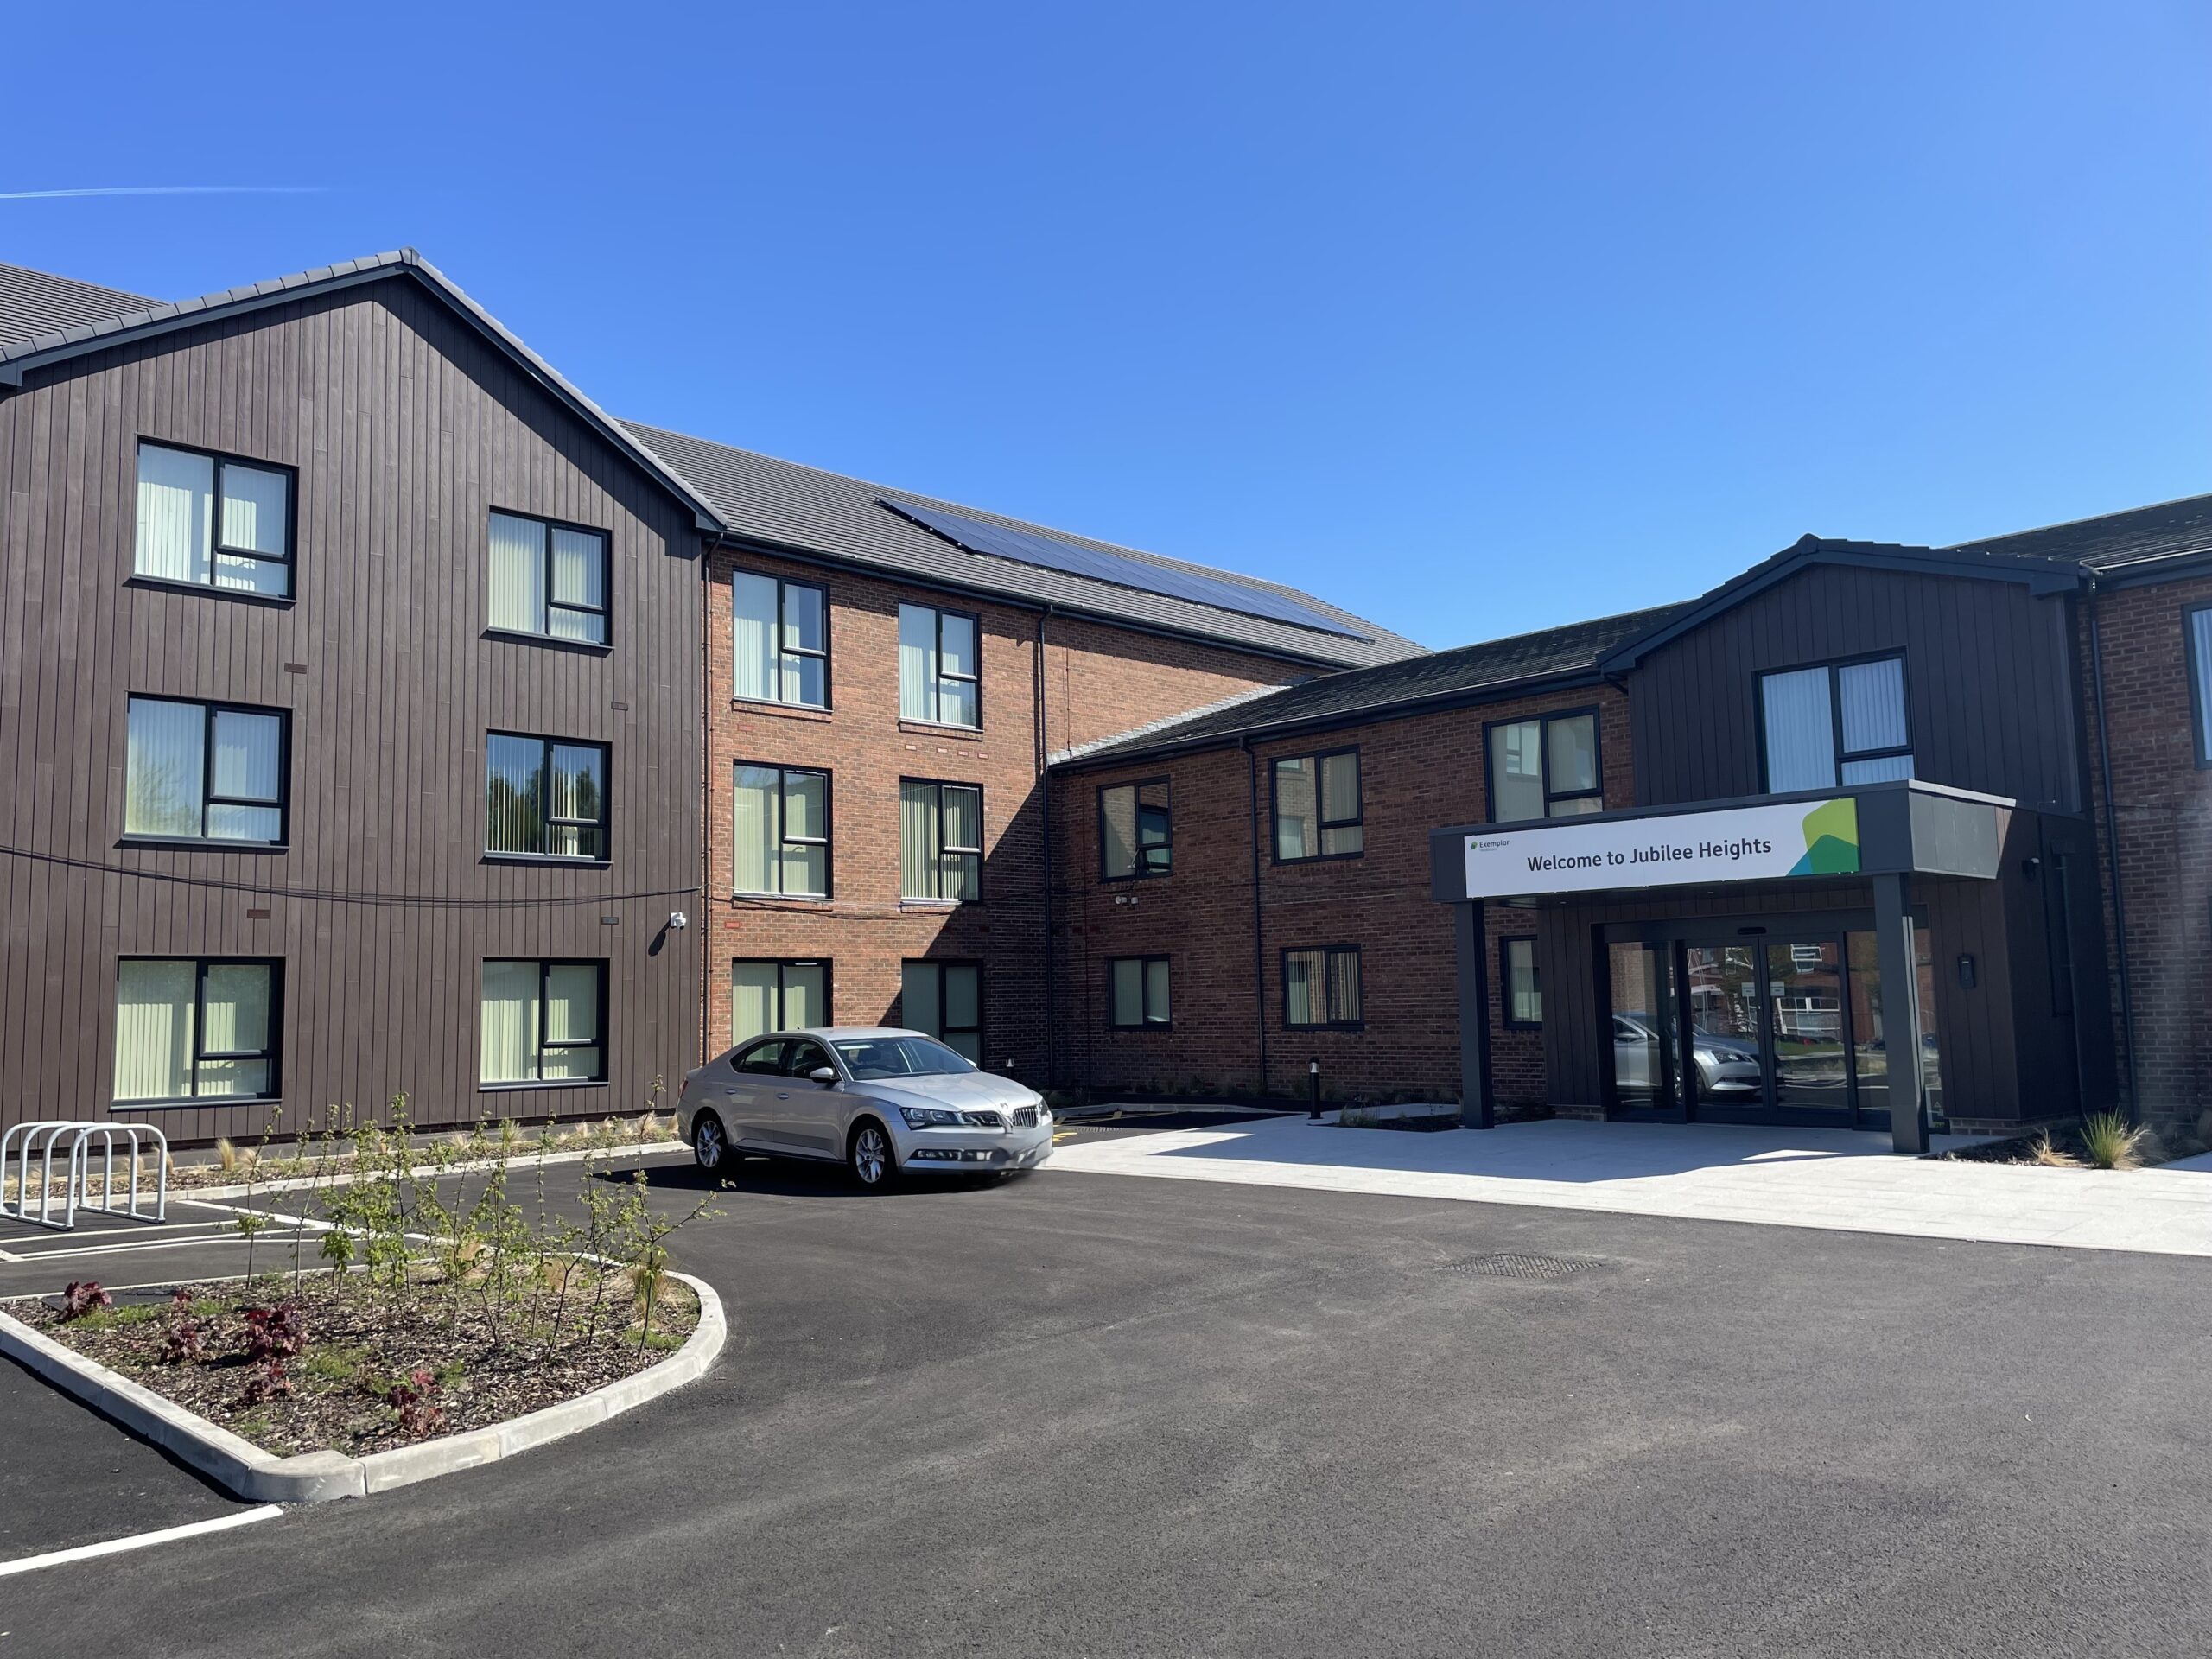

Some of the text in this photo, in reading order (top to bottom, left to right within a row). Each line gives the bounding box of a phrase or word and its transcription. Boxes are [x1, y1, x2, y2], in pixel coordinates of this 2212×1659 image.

[1527, 838, 1772, 871] Welcome to Jubilee Heights
